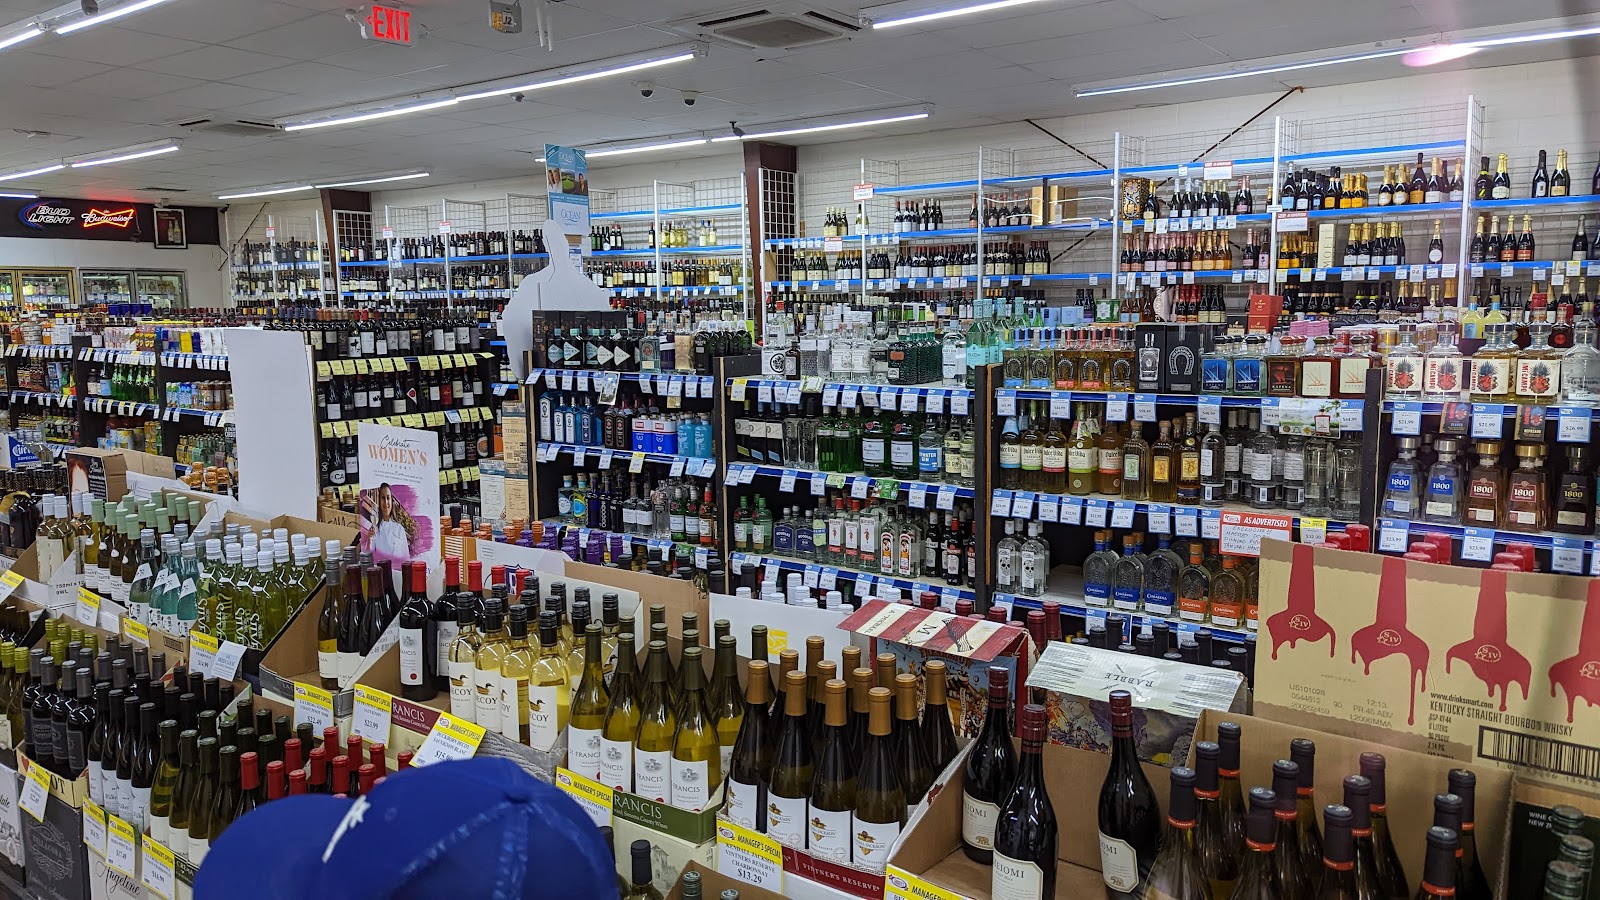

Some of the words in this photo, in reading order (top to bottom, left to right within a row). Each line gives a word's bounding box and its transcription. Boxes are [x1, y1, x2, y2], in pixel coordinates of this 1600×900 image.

[373, 5, 411, 43] EXIT
[36, 205, 71, 216] BUD
[81, 212, 133, 223] Budweiser
[560, 208, 580, 220] OCEAN
[28, 213, 75, 225] LIGHT
[380, 434, 421, 450] Celebrate
[368, 444, 428, 467] WOMEN'S
[382, 463, 412, 471] HISTORY
[1390, 478, 1410, 486] 1800
[1473, 486, 1493, 494] 1800
[1514, 488, 1534, 497] 1800
[1252, 518, 1288, 528] ADVERTISED
[1104, 672, 1154, 687] RABBLE
[1333, 700, 1342, 708] 90
[1366, 698, 1387, 708] 12:13
[1430, 692, 1494, 709] www.drinksmart.com
[392, 702, 426, 723] RANCIS
[530, 714, 550, 722] ECOY
[1353, 704, 1364, 713] PR
[1376, 710, 1394, 719] ABV
[1430, 700, 1465, 714] KENTUCKY
[1466, 708, 1503, 723] STRAIGHT
[1504, 714, 1542, 731] BOURBON
[1544, 722, 1573, 737] WHISKY
[307, 716, 322, 726] $22.49
[364, 720, 378, 729] $23.99
[450, 724, 468, 738] MANAGER'S
[467, 730, 482, 742] SPECIAL
[1432, 724, 1448, 733] LITERS
[453, 746, 467, 754] BLANC
[457, 741, 470, 750] DECOY
[574, 781, 596, 798] MANAGER'S
[596, 789, 612, 803] SPECIAL
[614, 794, 662, 820] RANCIS
[624, 811, 639, 821] Sonoma
[640, 816, 654, 826] County
[654, 820, 668, 830] Wines
[738, 834, 764, 852] MANAGER'S
[764, 844, 781, 859] SPECIAL
[726, 850, 752, 866] VINTNERS
[752, 860, 775, 874] RESERVE
[750, 852, 775, 866] JACKSON
[732, 859, 768, 878] CHARDONNAY
[737, 868, 762, 886] $13.29
[803, 862, 842, 882] VINTNER'S
[842, 876, 877, 892] RESERVE
